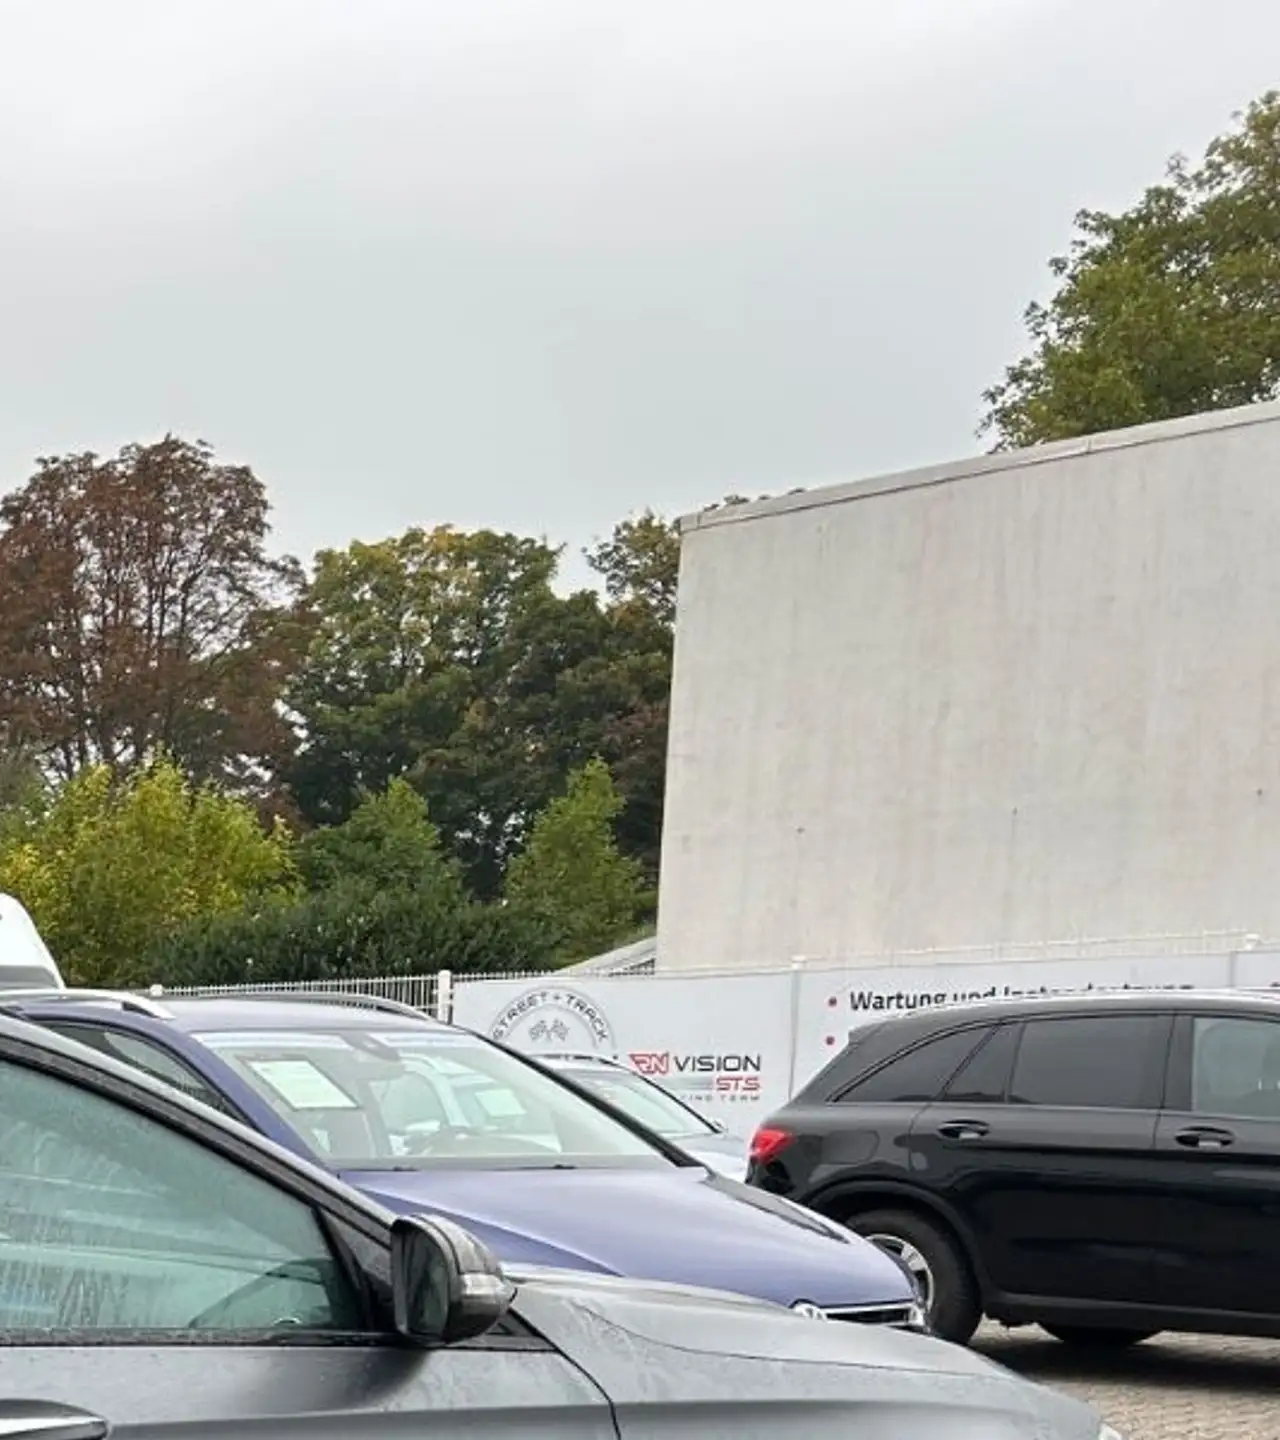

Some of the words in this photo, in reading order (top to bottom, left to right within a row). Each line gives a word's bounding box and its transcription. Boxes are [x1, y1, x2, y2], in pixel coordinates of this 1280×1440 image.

[849, 991, 947, 1011] Wartung
[493, 991, 547, 1040] STREET
[566, 993, 608, 1042] TRACK
[673, 1055, 761, 1072] VISION
[716, 1077, 761, 1091] STS
